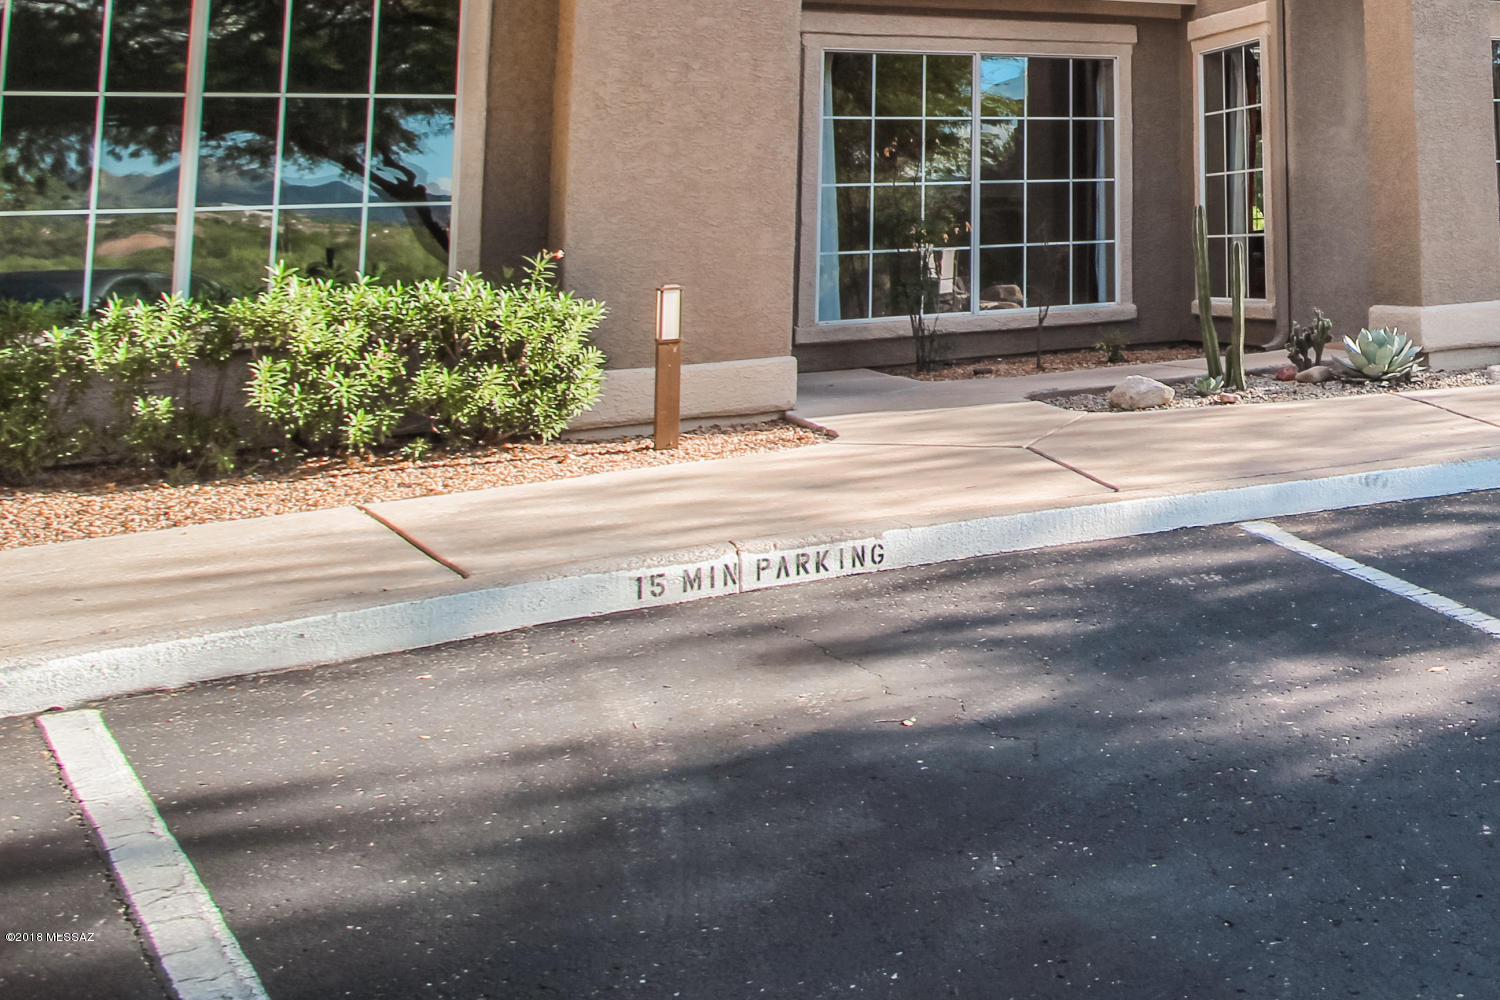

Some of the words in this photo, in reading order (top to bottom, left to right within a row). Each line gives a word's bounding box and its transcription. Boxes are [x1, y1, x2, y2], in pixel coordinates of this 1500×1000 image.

[635, 573, 666, 600] 15
[683, 563, 738, 593] MIN
[756, 543, 886, 582] PARKING
